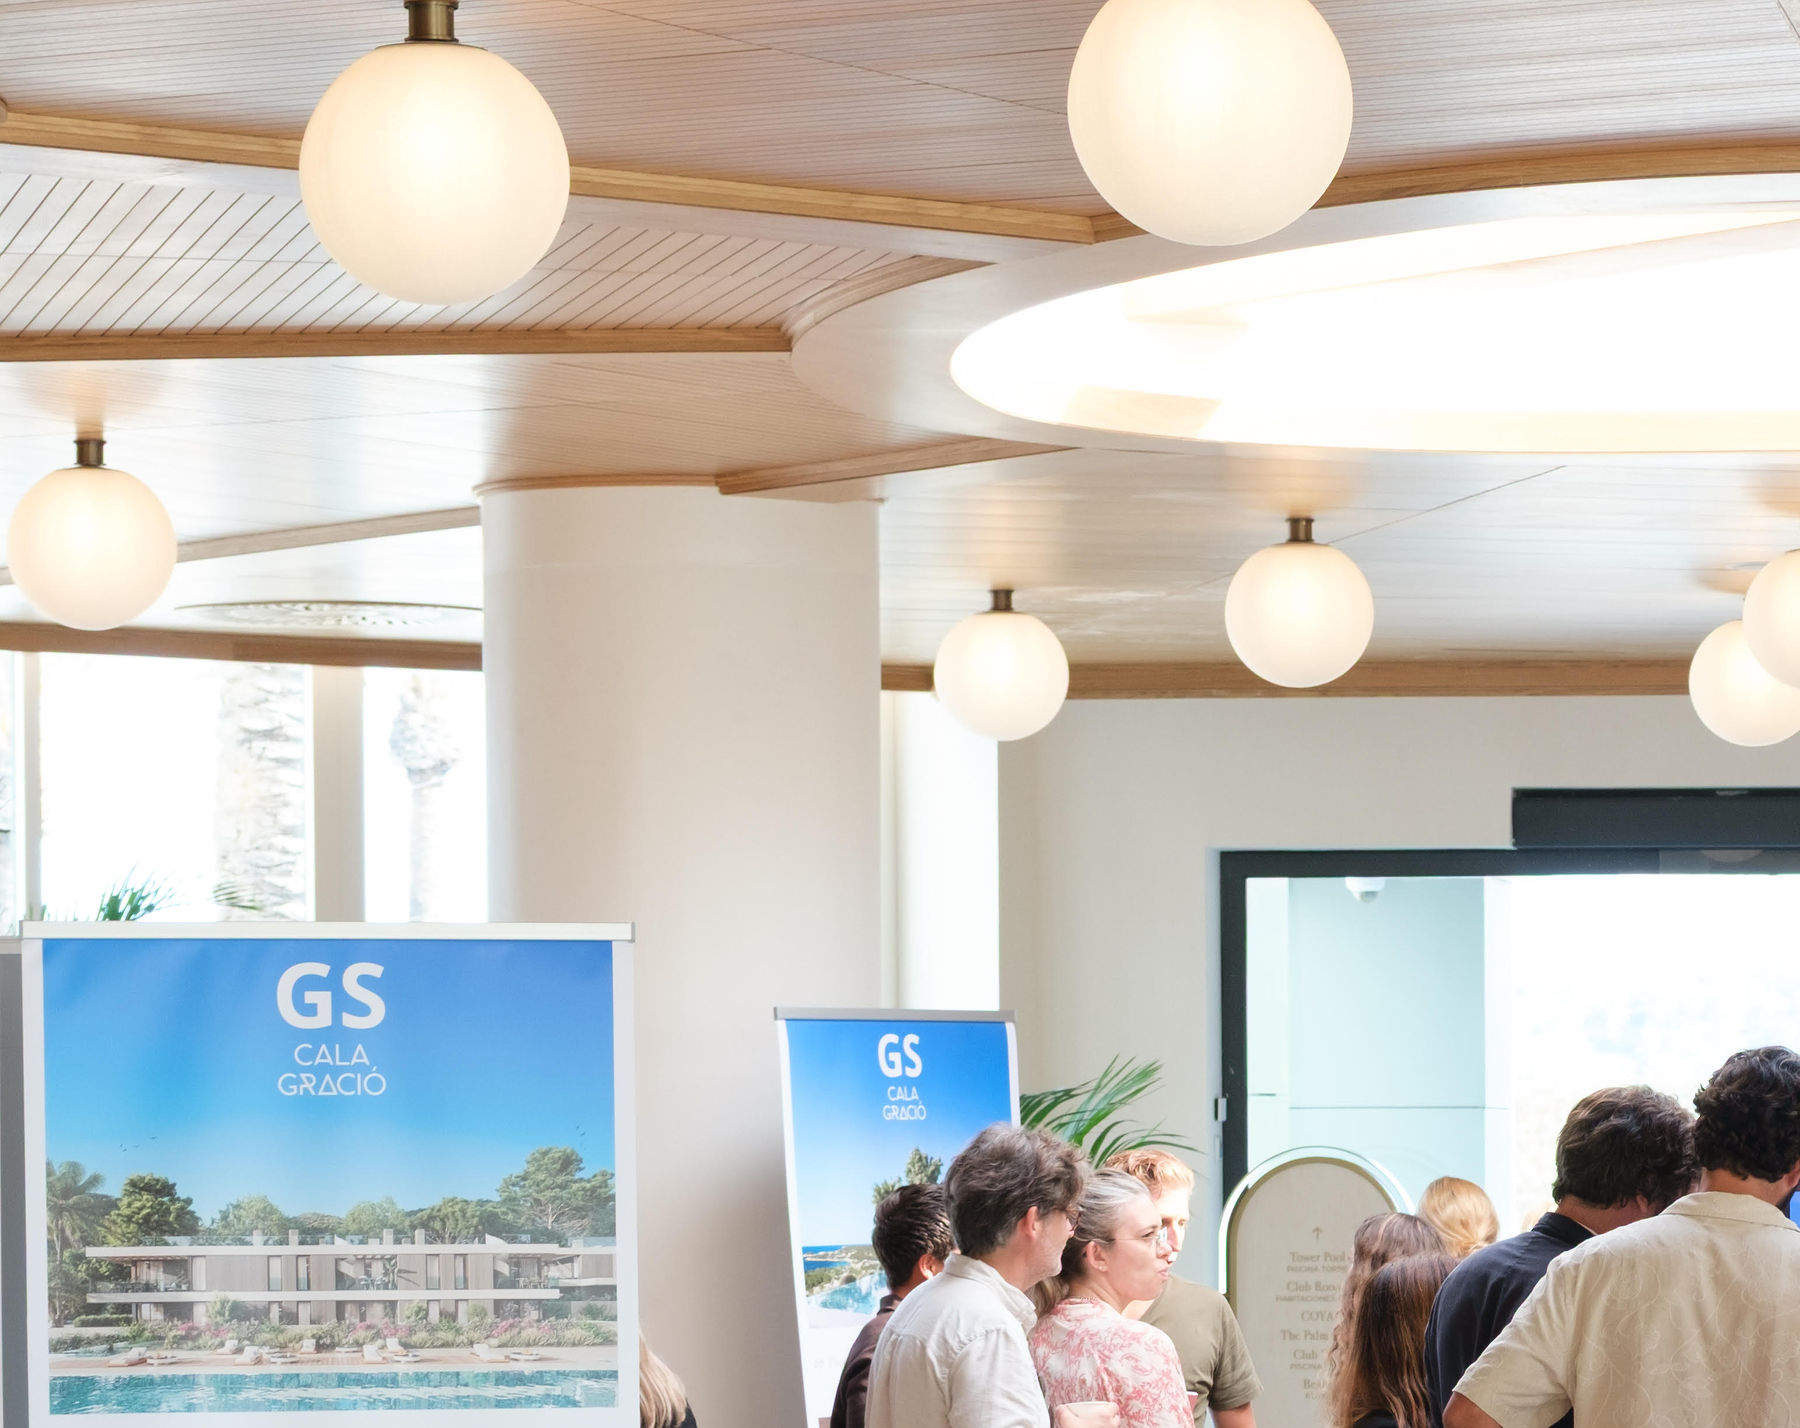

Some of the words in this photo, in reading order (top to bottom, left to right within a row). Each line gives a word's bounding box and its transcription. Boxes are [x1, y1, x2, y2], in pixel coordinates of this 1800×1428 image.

[276, 961, 386, 1030] GS
[293, 1043, 371, 1067] CALA
[878, 1033, 923, 1078] GS
[277, 1065, 387, 1096] GRACIÓ
[887, 1085, 920, 1102] CALA
[882, 1101, 927, 1121] GRACIÓ
[1289, 1251, 1321, 1262] Tower
[1323, 1251, 1346, 1262] Pool
[1286, 1281, 1312, 1292] Club
[1300, 1310, 1334, 1322] COYA
[1280, 1329, 1300, 1341] The
[1303, 1329, 1329, 1341] Palm
[1293, 1349, 1318, 1360] Club
